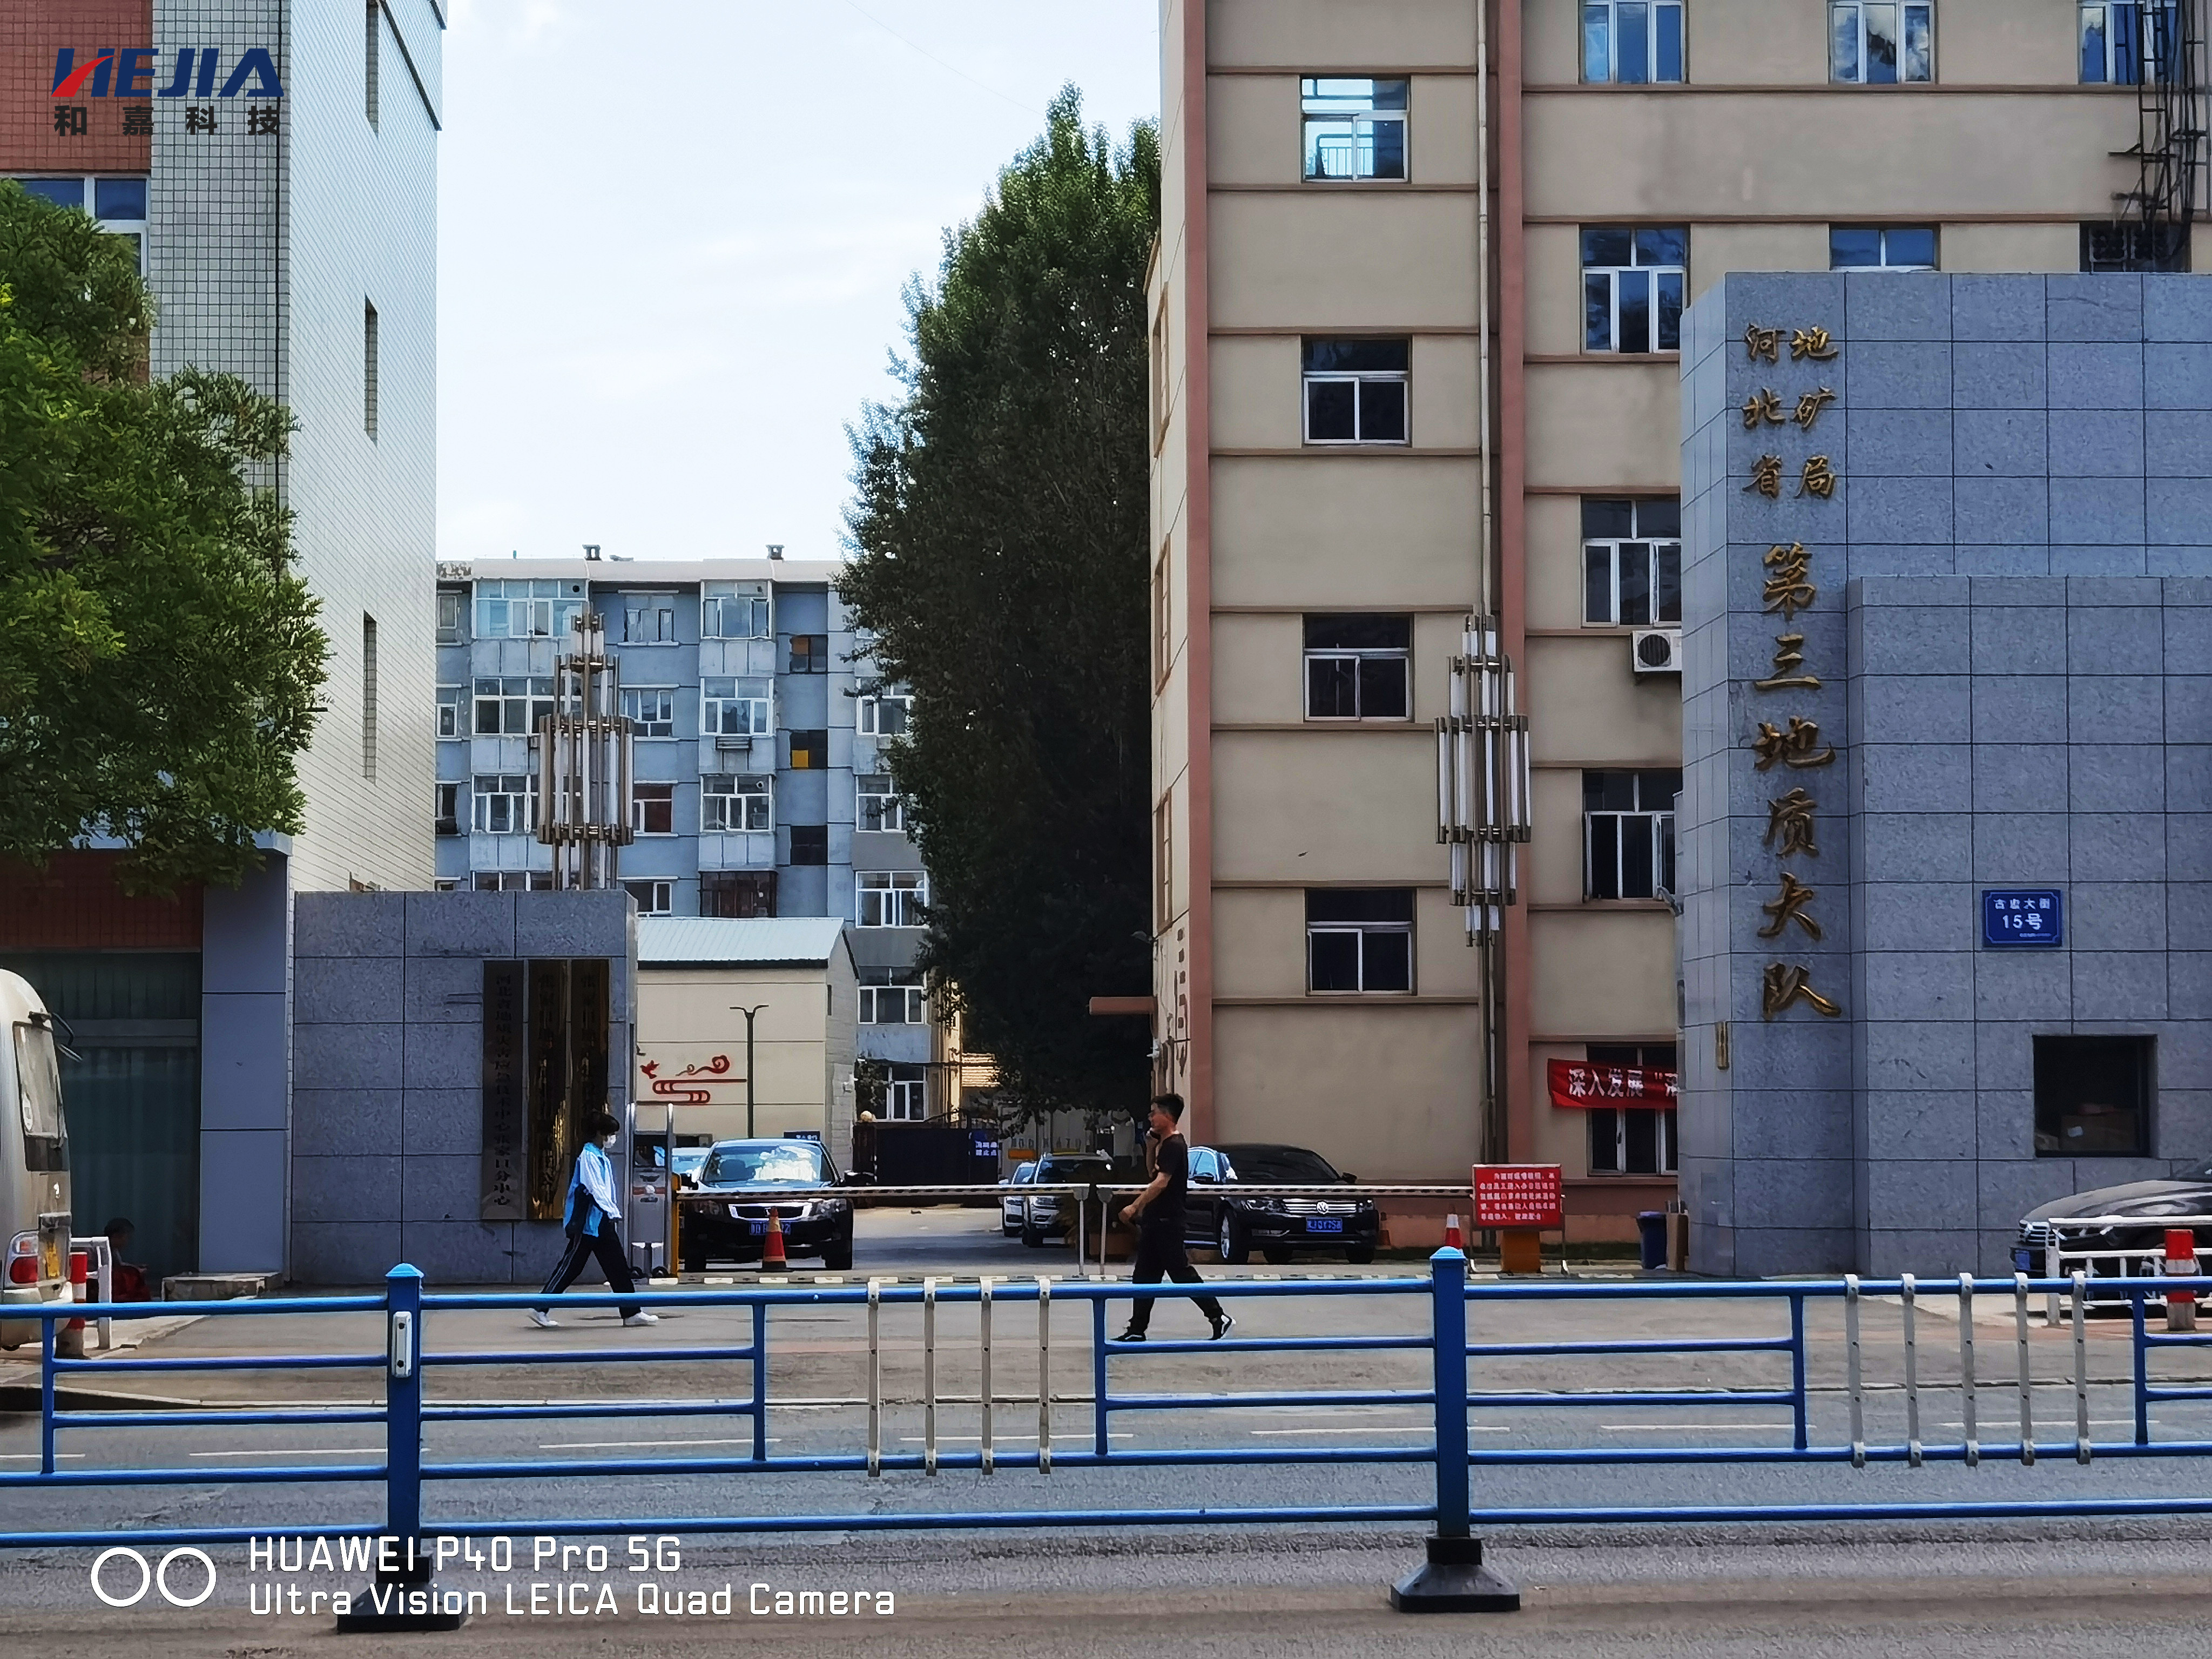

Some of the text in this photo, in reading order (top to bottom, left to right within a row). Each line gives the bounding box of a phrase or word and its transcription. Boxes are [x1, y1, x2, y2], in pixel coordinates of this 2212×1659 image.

[1743, 323, 1786, 498] 河北省
[1789, 325, 1838, 499] 地矿局
[1752, 542, 1841, 1021] 第三地质大队
[2002, 913, 2043, 930] 15号
